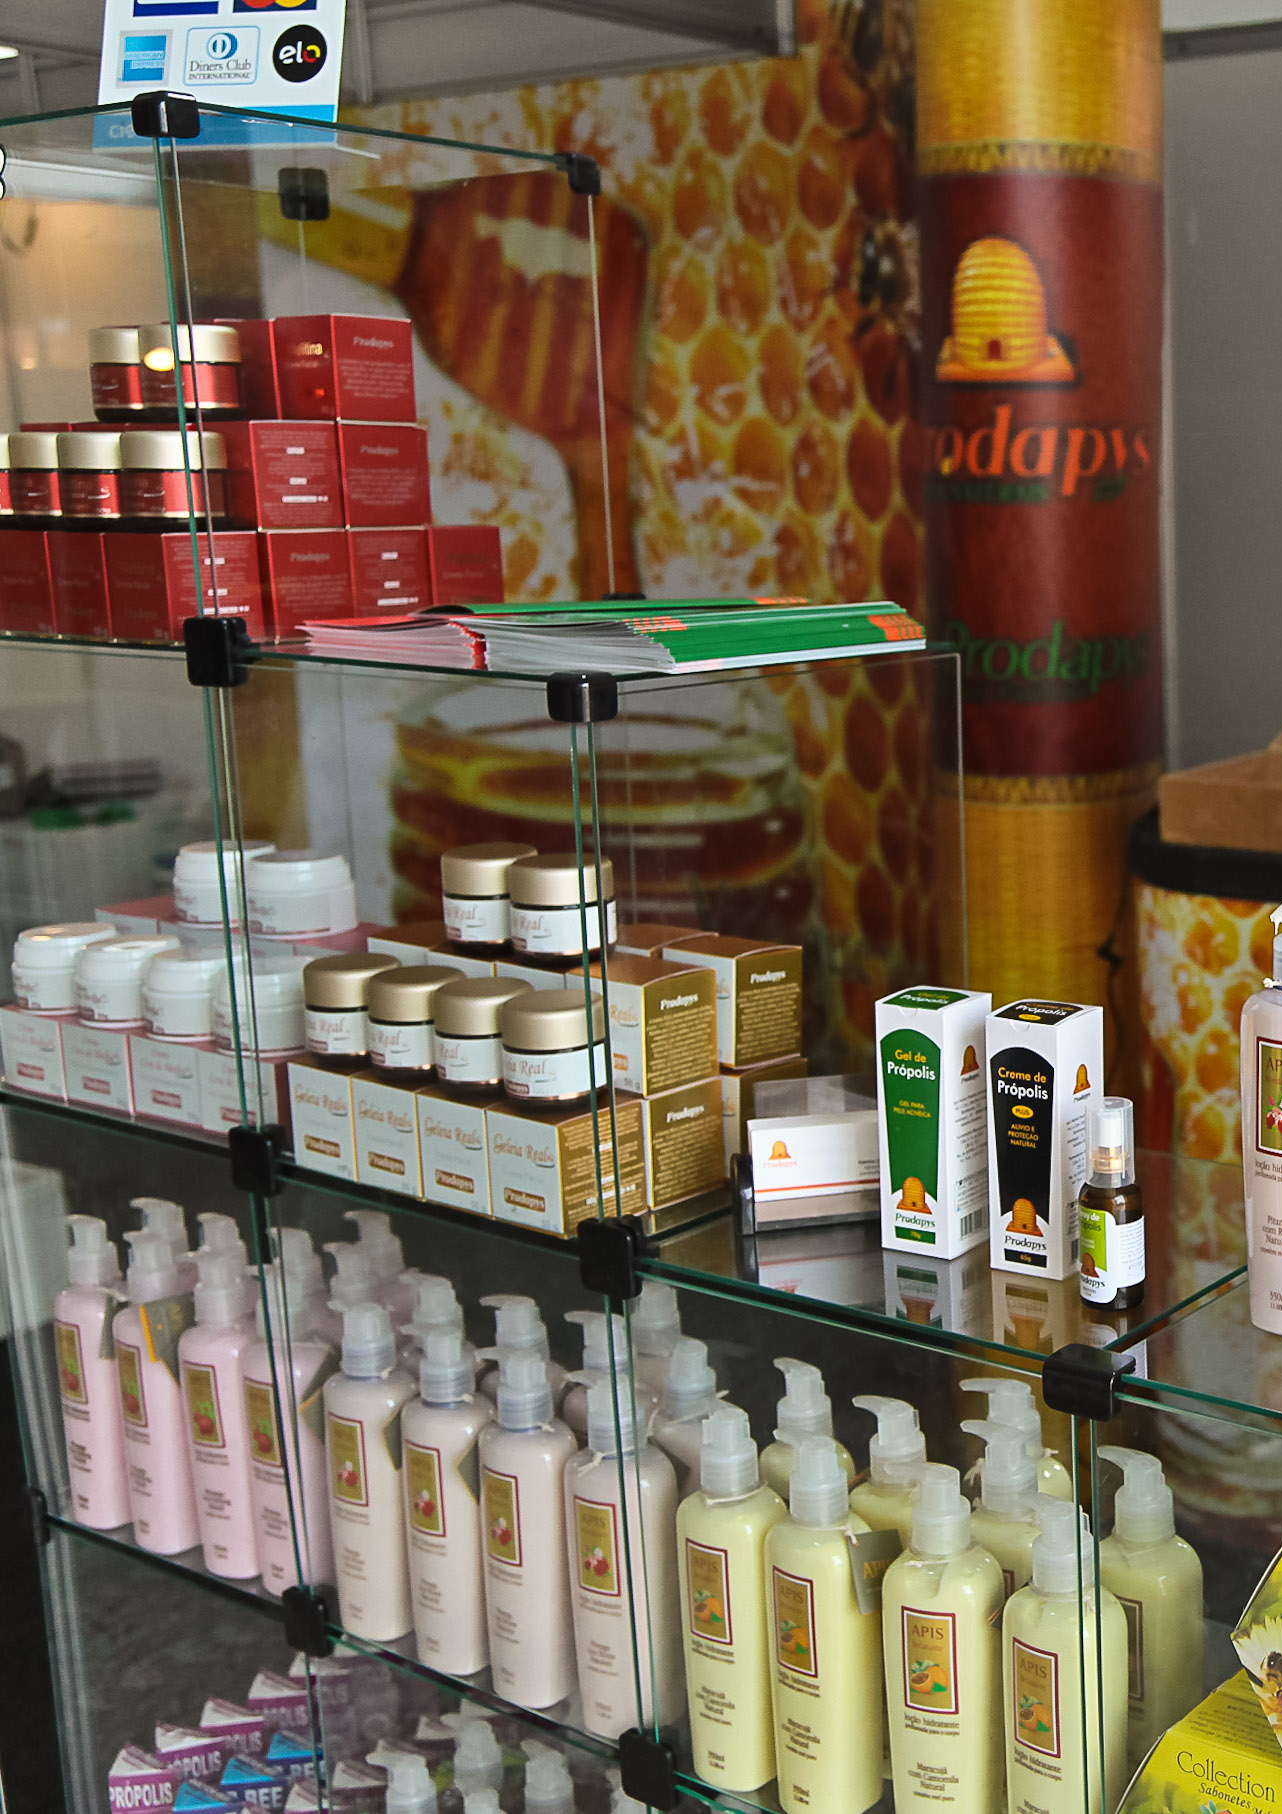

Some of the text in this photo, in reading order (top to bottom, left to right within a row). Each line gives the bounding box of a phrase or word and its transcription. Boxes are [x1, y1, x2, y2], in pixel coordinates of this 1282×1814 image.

[279, 41, 321, 64] elo
[190, 59, 251, 72] Diners Club
[1016, 1004, 1067, 1016] Própolis
[895, 1049, 927, 1063] Gel de
[887, 1061, 936, 1081] Própolis
[998, 1067, 1046, 1083] Creme de
[997, 1080, 1048, 1100] Própolis
[1010, 1139, 1037, 1148] NATURAL
[895, 1213, 936, 1228] Prodapys
[1091, 1213, 1100, 1221] de
[1004, 1235, 1047, 1251] Prodapys
[912, 1624, 945, 1640] APIS
[1020, 1658, 1047, 1679] APIS
[1177, 1750, 1275, 1803] Collection
[1198, 1782, 1251, 1809] Sabonetes
